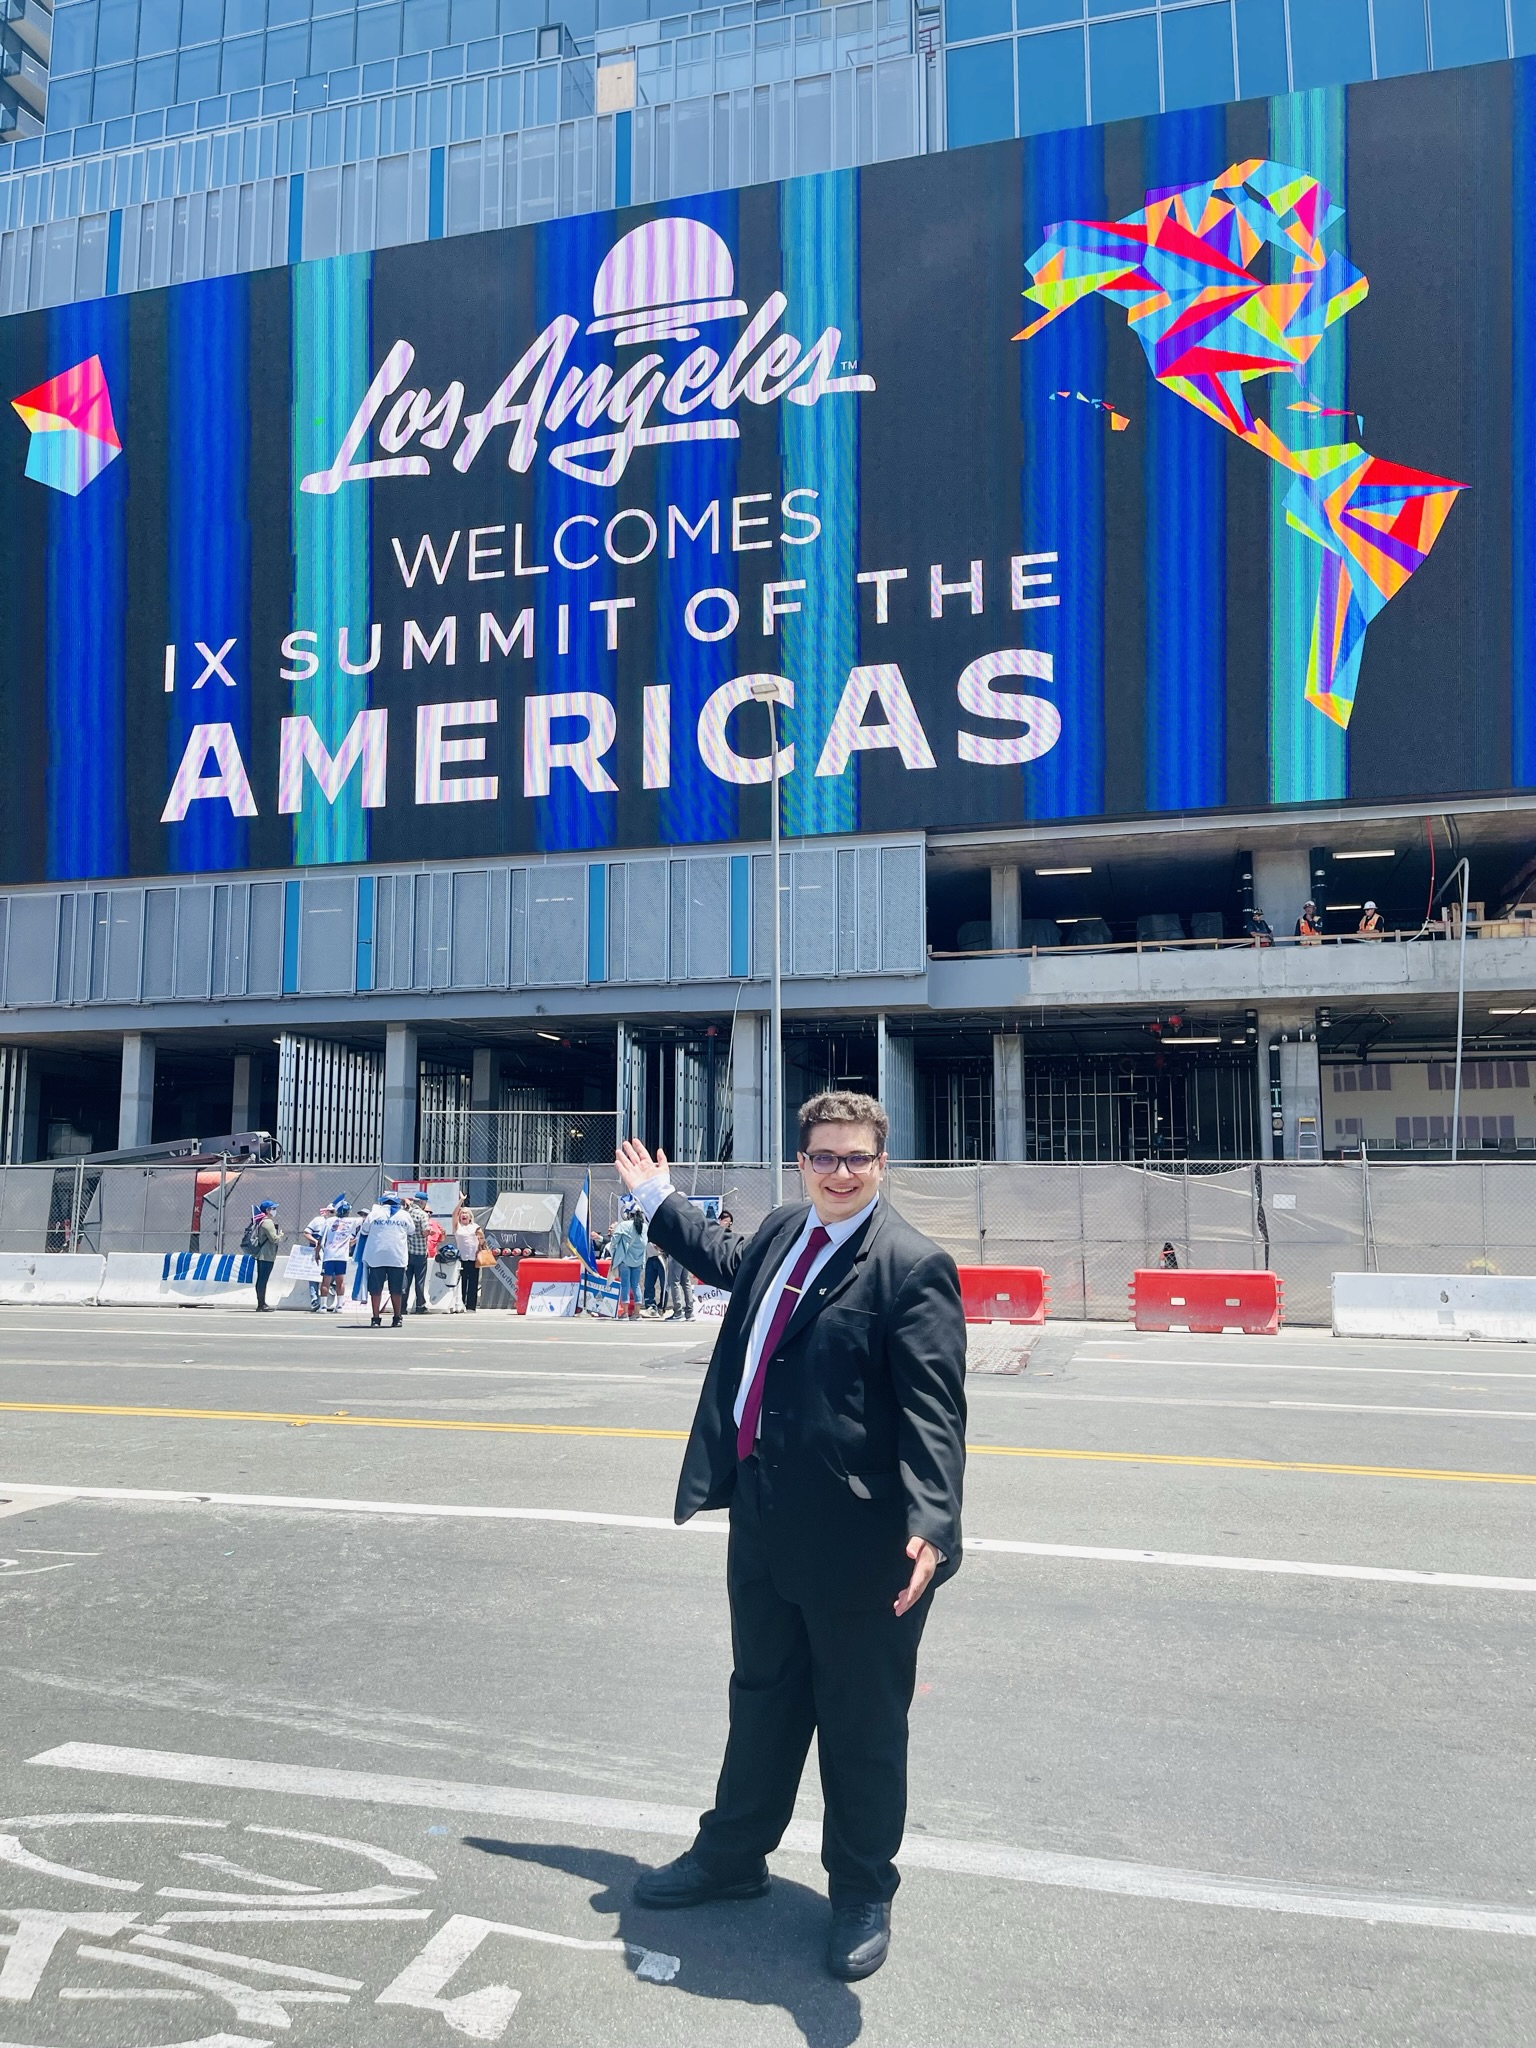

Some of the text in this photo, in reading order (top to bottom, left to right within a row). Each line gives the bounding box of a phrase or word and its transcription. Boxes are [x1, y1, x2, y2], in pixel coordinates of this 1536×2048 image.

[300, 290, 877, 495] Los Angeles
[840, 359, 858, 371] TM
[391, 488, 822, 588] WELCOMES
[164, 551, 1061, 693] IX SUMMIT OF THE
[160, 648, 1062, 823] AMERICAS
